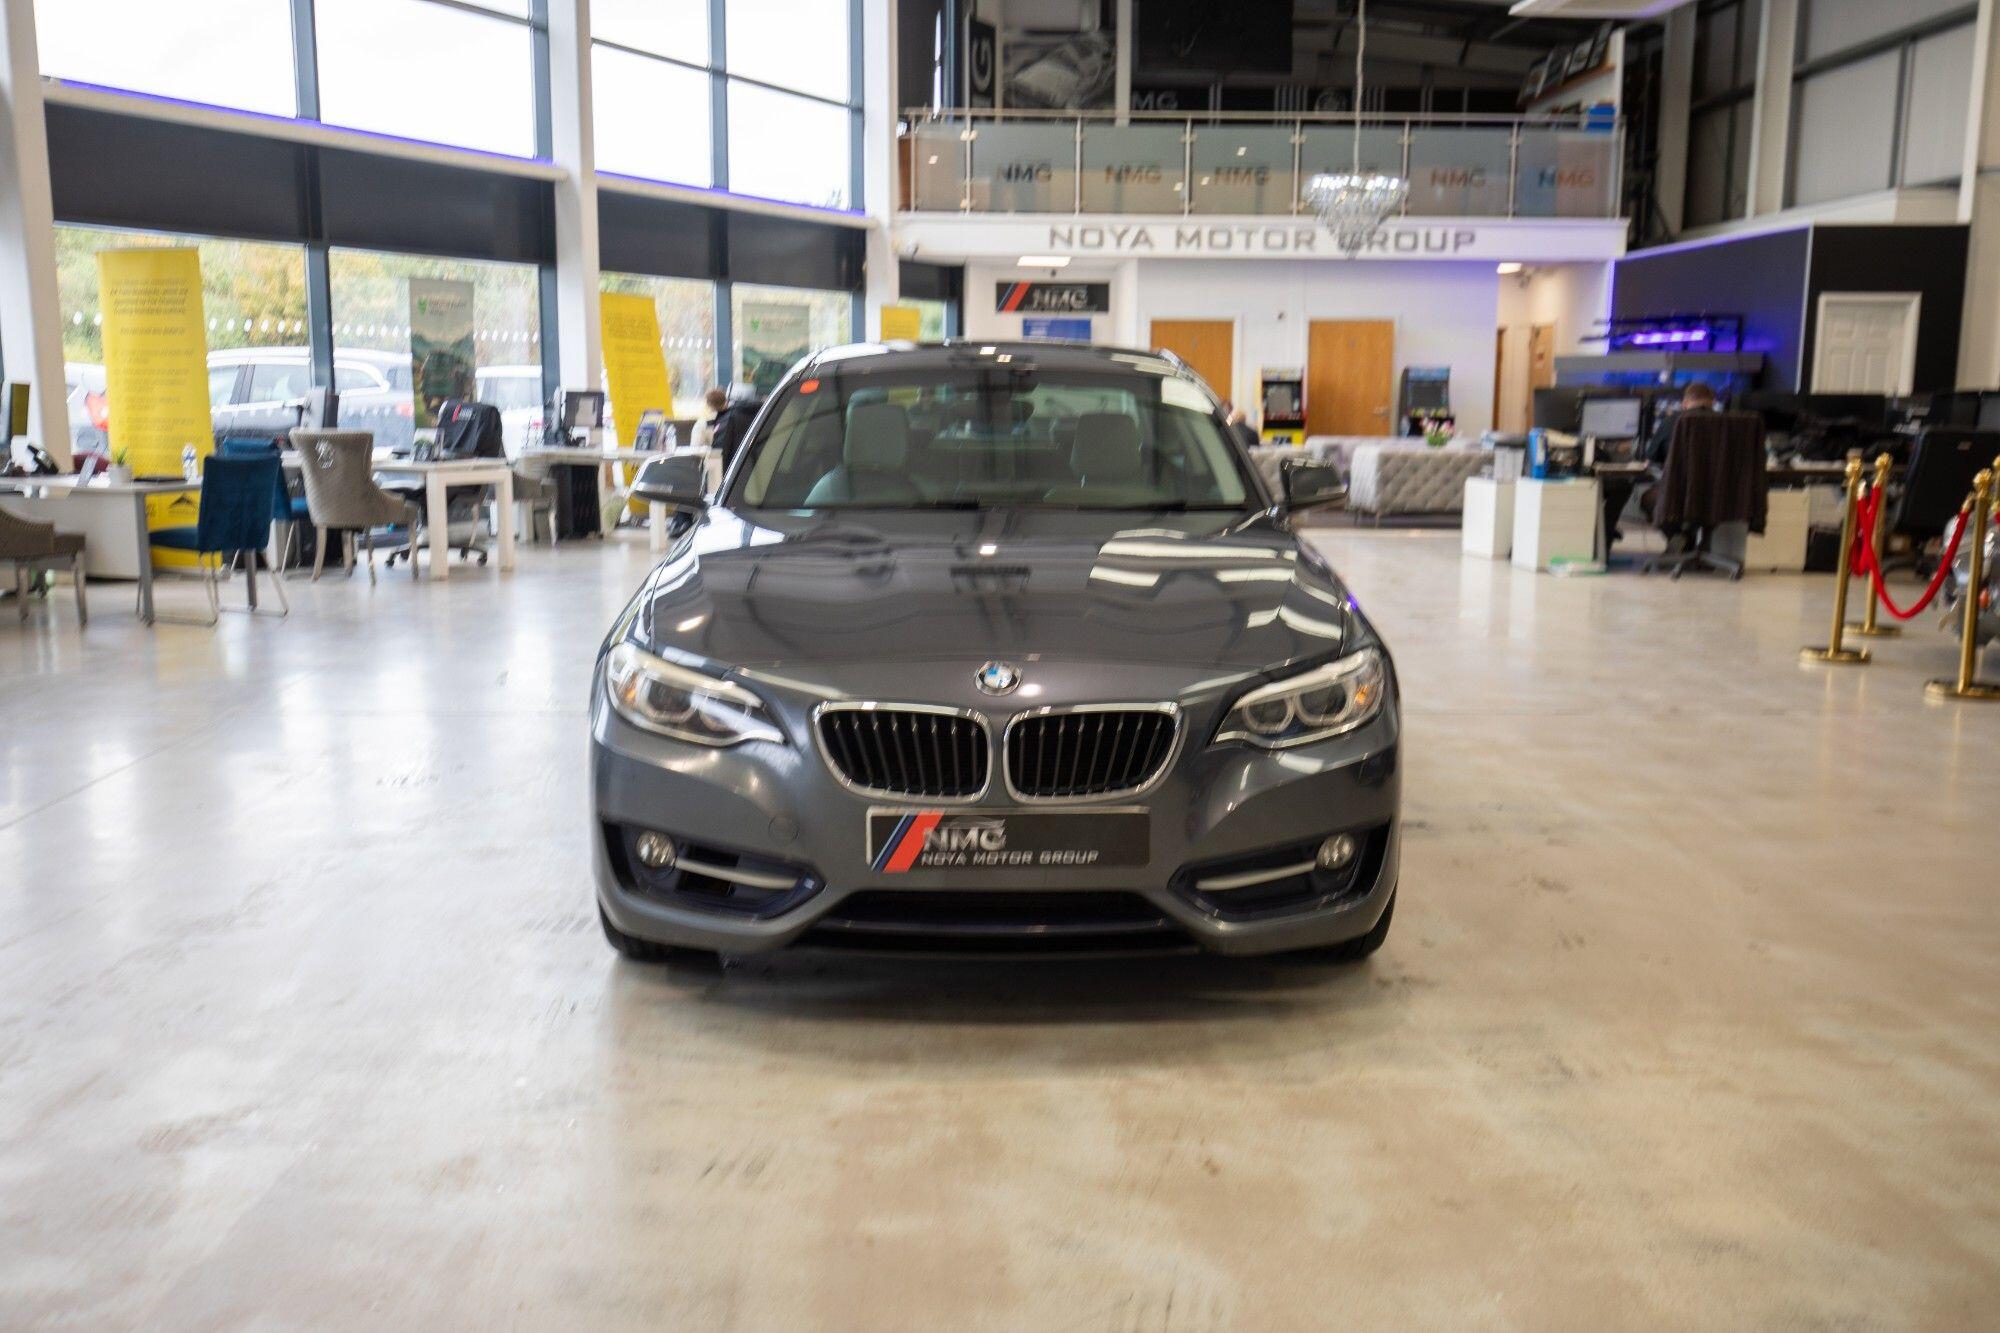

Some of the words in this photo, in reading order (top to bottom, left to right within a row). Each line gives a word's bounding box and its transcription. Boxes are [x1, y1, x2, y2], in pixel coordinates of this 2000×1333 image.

[997, 163, 1052, 183] NMG
[1105, 164, 1162, 183] NMG
[1430, 167, 1486, 187] NMG
[1538, 168, 1594, 187] NMG
[1050, 226, 1154, 249] NOYA
[1175, 227, 1316, 250] MOTOR
[923, 824, 1006, 850] NMG
[920, 851, 966, 866] NOYA
[973, 850, 1033, 866] MOTOR
[1039, 850, 1099, 865] GROUP
